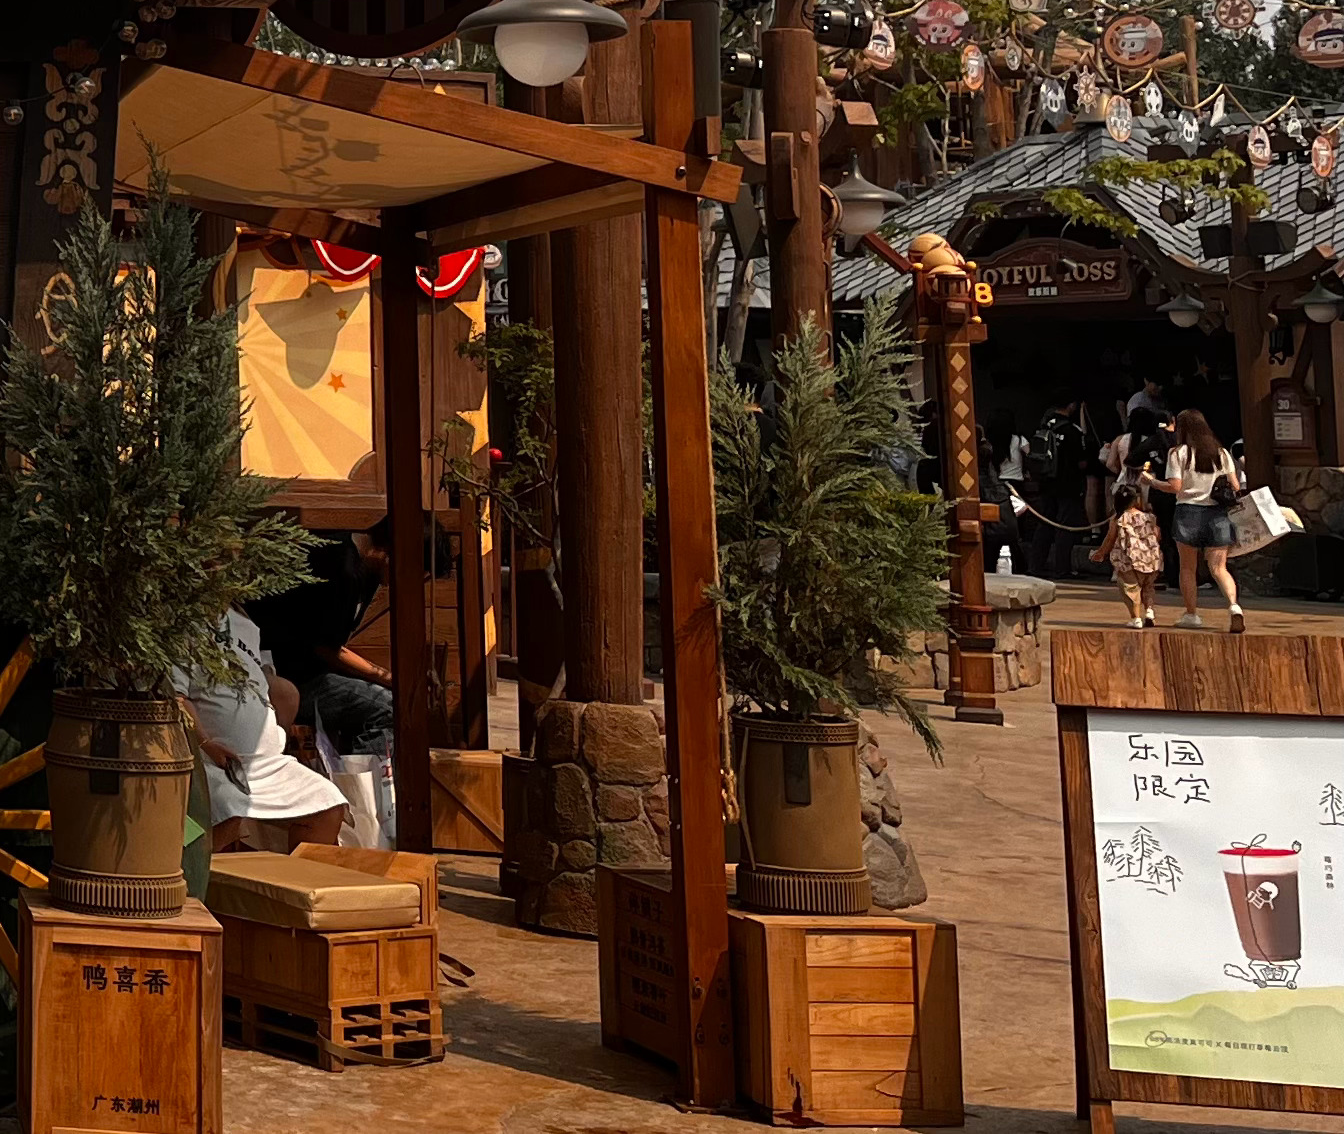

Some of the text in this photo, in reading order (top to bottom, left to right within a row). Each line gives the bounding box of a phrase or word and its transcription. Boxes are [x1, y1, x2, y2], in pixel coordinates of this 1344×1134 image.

[1063, 260, 1117, 283] OSS
[1127, 733, 1204, 768] 乐园
[1133, 772, 1211, 804] 限定
[82, 963, 171, 996] 鸭喜香
[91, 1094, 161, 1116] 广东潮州
